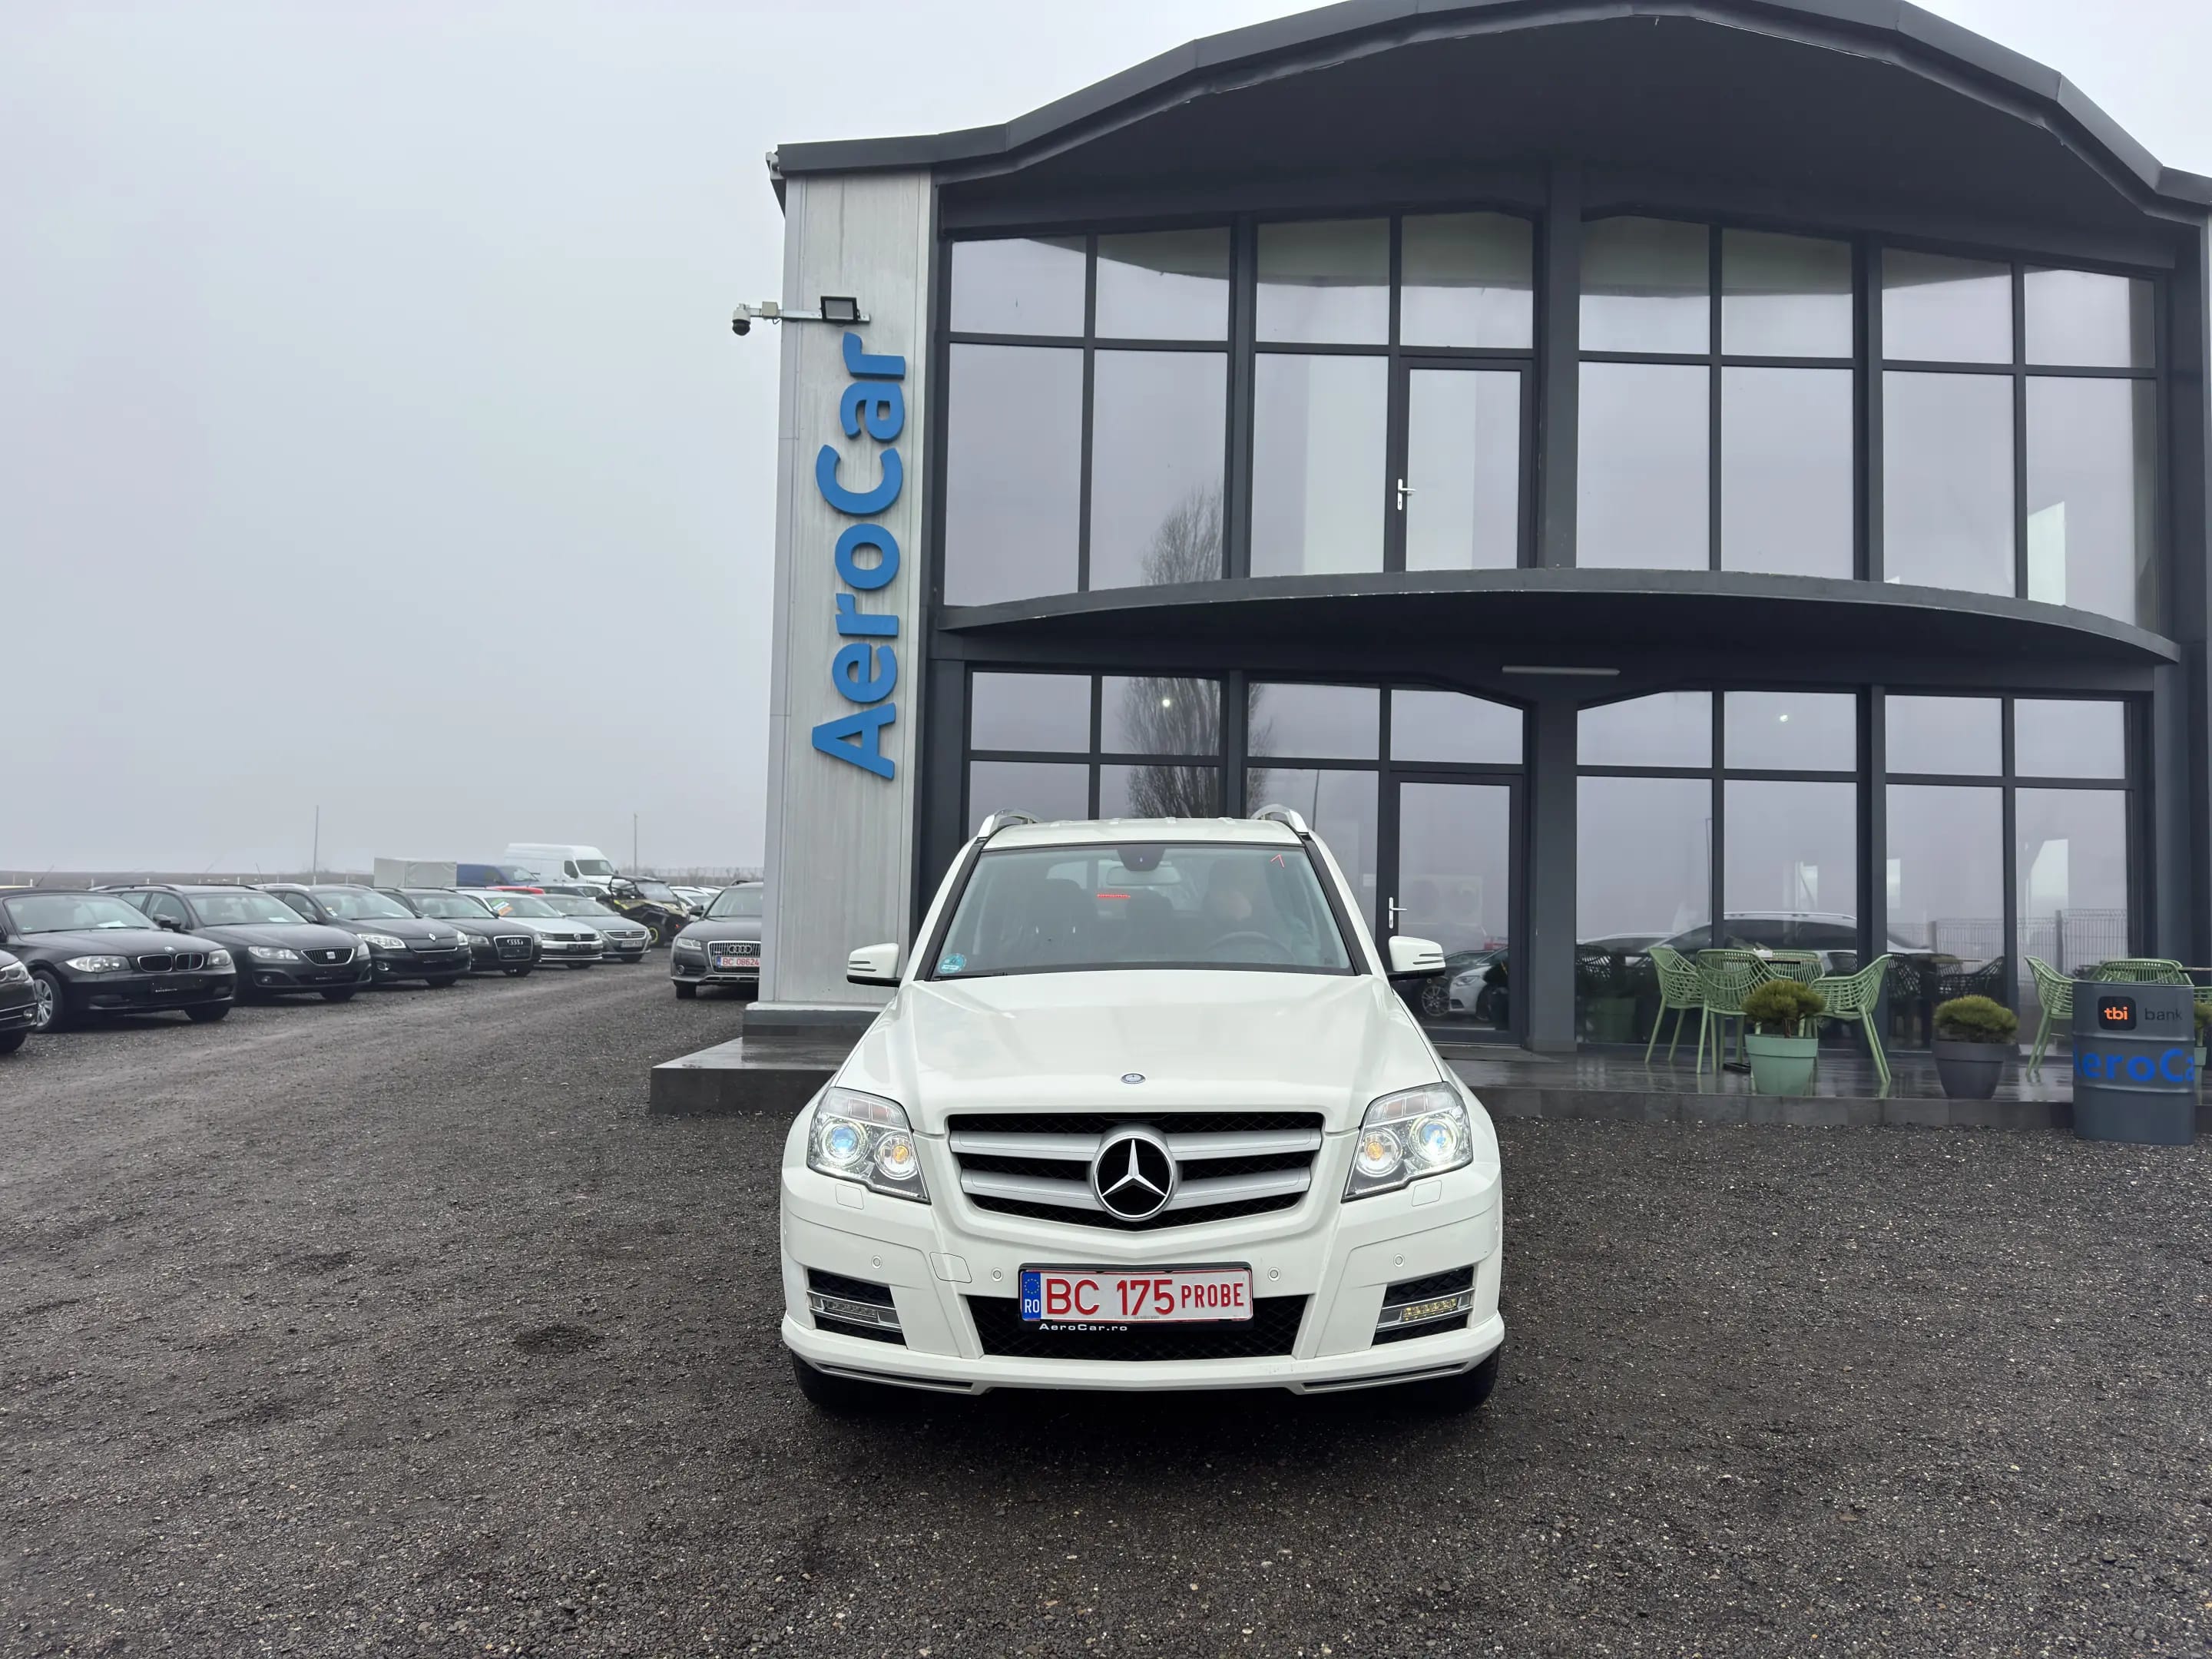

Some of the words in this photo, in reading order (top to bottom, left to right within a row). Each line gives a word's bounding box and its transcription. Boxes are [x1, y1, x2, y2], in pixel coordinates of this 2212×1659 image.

[812, 332, 906, 780] AeroCar
[723, 958, 734, 966] BC
[2104, 1007, 2128, 1021] tbi
[2144, 1008, 2182, 1021] bank
[1045, 1279, 1100, 1315] BC
[1117, 1279, 1175, 1316] 175
[1181, 1283, 1244, 1309] PROBE
[1024, 1298, 1040, 1313] RO
[1038, 1323, 1128, 1331] AeroCar.ro
